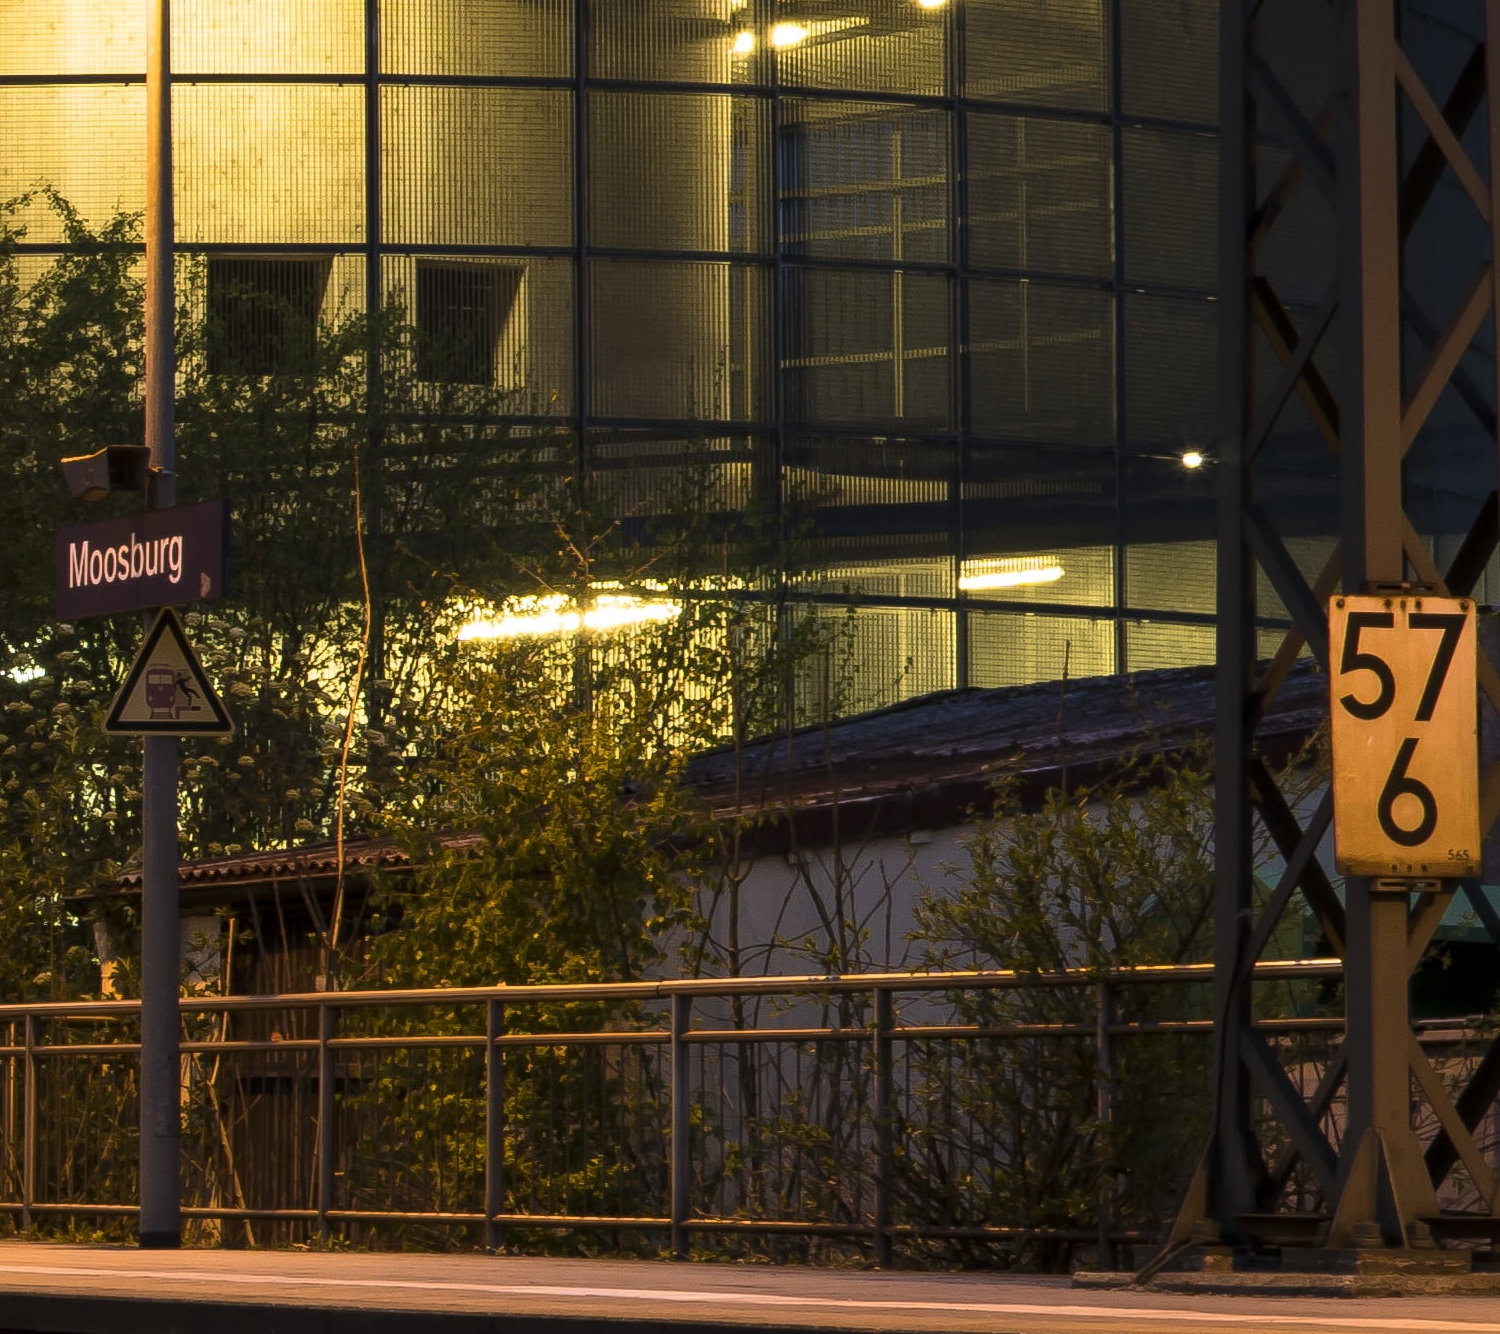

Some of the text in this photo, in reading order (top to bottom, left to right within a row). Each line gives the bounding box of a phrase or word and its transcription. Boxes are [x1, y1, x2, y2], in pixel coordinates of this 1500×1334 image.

[68, 532, 184, 589] Moosburg
[1339, 611, 1468, 722] 57
[1377, 737, 1438, 847] 6
